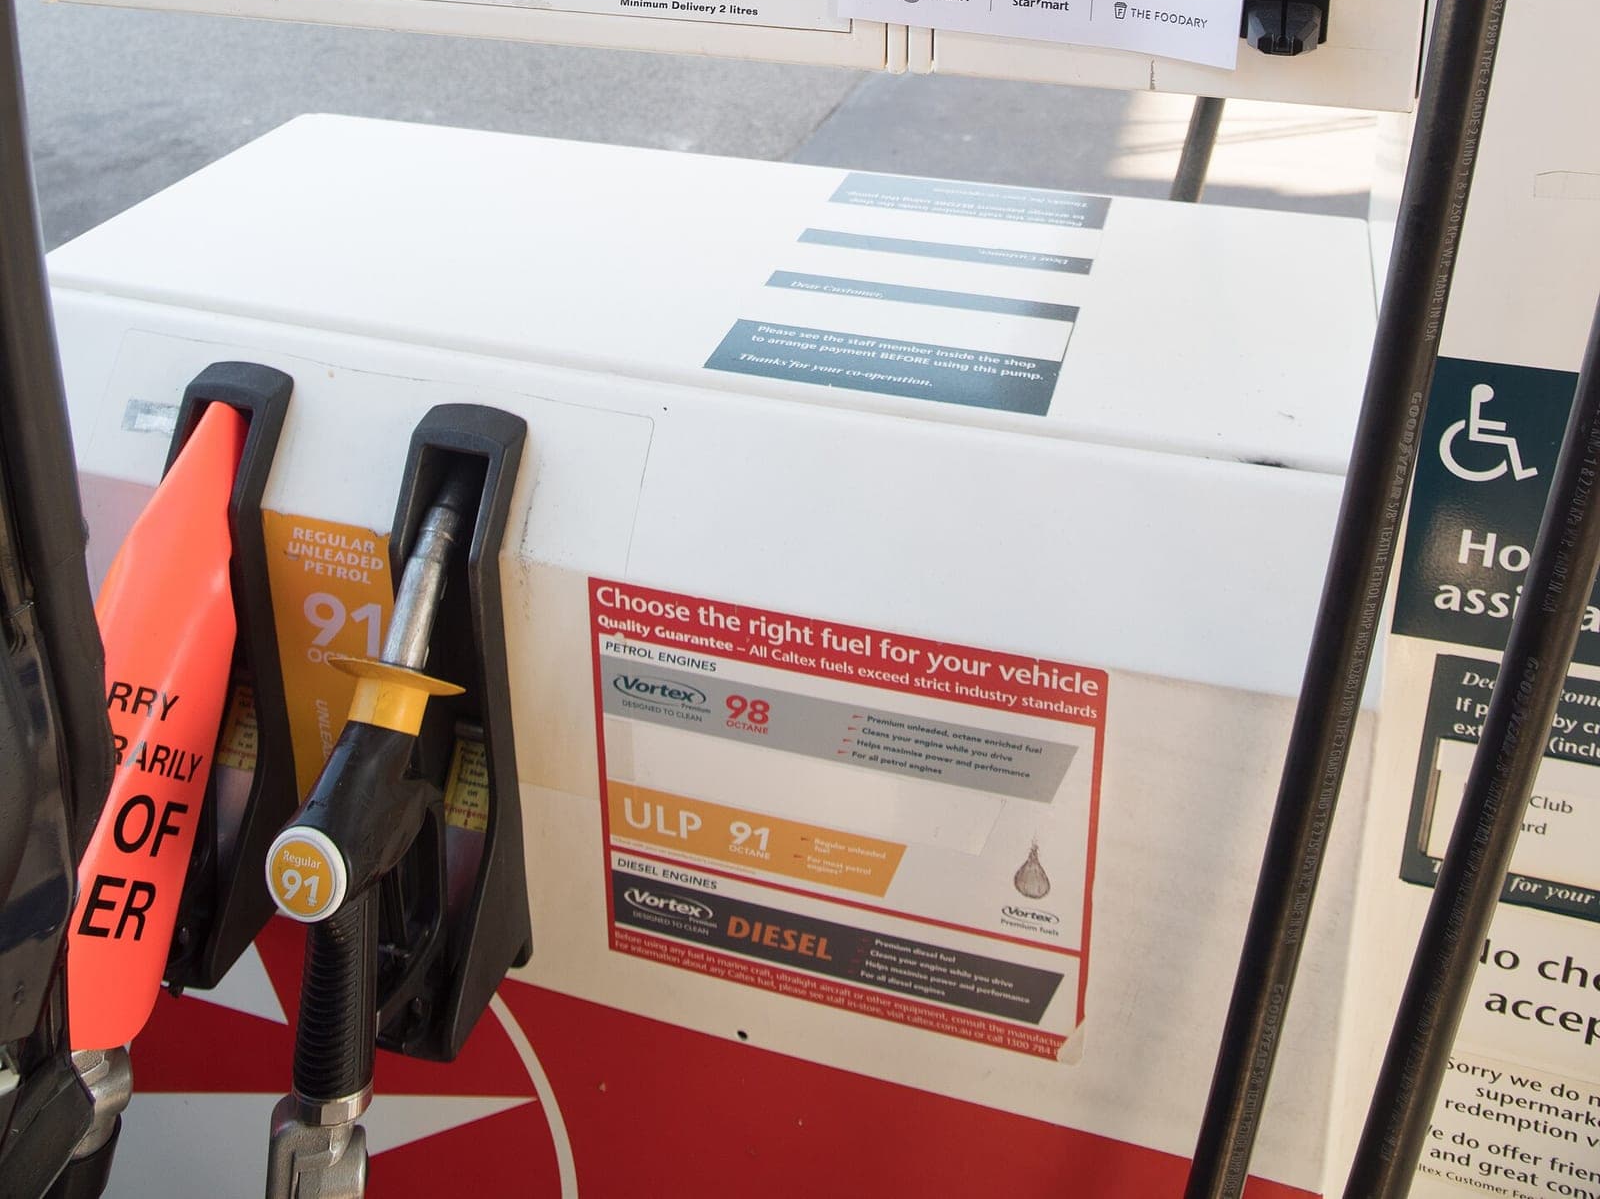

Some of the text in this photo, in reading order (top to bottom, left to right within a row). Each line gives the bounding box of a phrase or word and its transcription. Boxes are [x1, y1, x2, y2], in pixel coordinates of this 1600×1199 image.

[672, 1, 716, 14] Delivery
[719, 5, 726, 13] 2
[730, 5, 758, 15] litres
[1131, 8, 1207, 28] THE FOODARY
[740, 353, 932, 386] Thanks for your co-operation.
[767, 338, 817, 349] arrange
[819, 345, 876, 357] payment
[880, 352, 930, 365] BEFORE
[934, 361, 969, 371] using
[973, 362, 998, 374] this
[1000, 363, 1043, 380] pump.
[1391, 391, 1422, 500] GOODYEAR
[293, 526, 376, 554] REGULAR
[1376, 525, 1394, 563] TEXTILE
[288, 541, 383, 571] UNLEADED
[304, 560, 371, 586] PETROL
[1366, 565, 1384, 601] PETROL
[303, 592, 383, 658] 91
[1360, 603, 1377, 629] PUMP
[597, 586, 1098, 696] Choose the right fuel for your vehicle
[606, 641, 716, 672] PETROL ENGINES
[1354, 631, 1371, 656] HOSE
[598, 615, 1097, 718] Quality Guarantee All Caltex fuels exceed strict industry standards
[620, 675, 696, 703] Vortex
[726, 695, 770, 724] 98
[726, 720, 768, 734] OCTANE
[113, 794, 188, 858] OF
[624, 798, 702, 839] ULP
[730, 822, 769, 852] 91
[282, 849, 322, 871] Regular
[615, 858, 717, 889] DIESEL ENGINES
[281, 868, 321, 907] 91
[1510, 876, 1596, 904] for your
[727, 916, 831, 960] DIESEL
[1509, 1075, 1580, 1102] we do
[1444, 1099, 1578, 1143] redemption
[1451, 1132, 1543, 1167] do offer
[1430, 1148, 1539, 1187] and great
[1446, 1170, 1509, 1196] Customer
